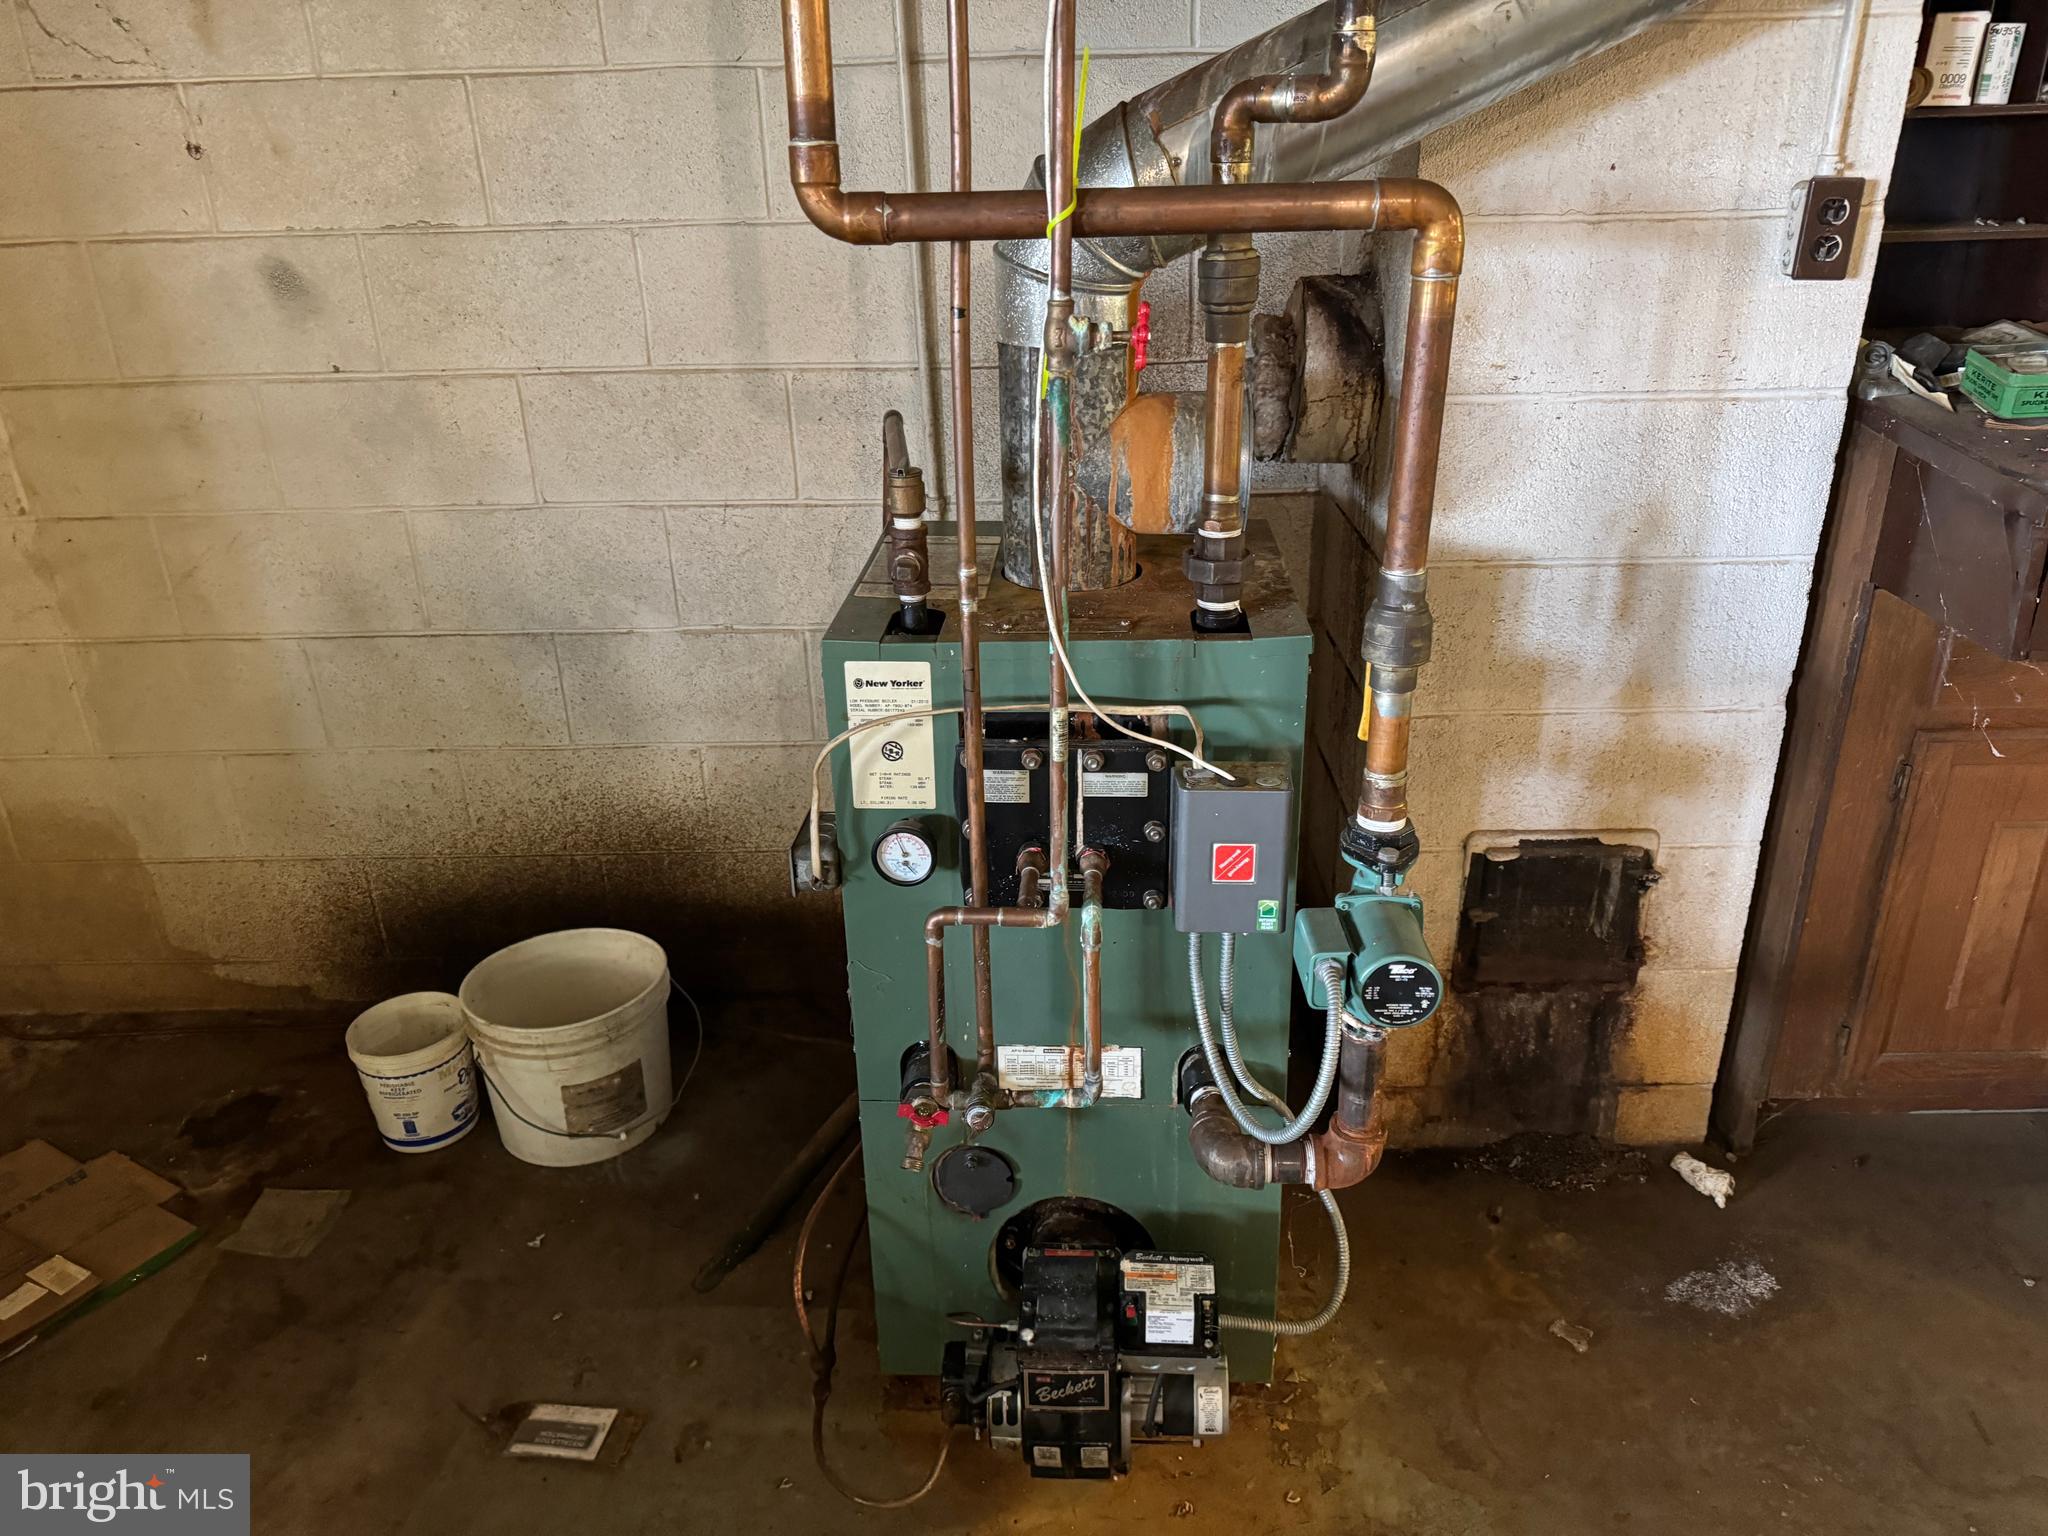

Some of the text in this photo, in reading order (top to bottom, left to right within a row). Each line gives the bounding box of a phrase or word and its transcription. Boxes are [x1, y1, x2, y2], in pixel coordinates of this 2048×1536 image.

[1971, 369, 1997, 391] KERITE
[1135, 1252, 1163, 1260] Beckett
[1035, 1376, 1097, 1402] Beckett
